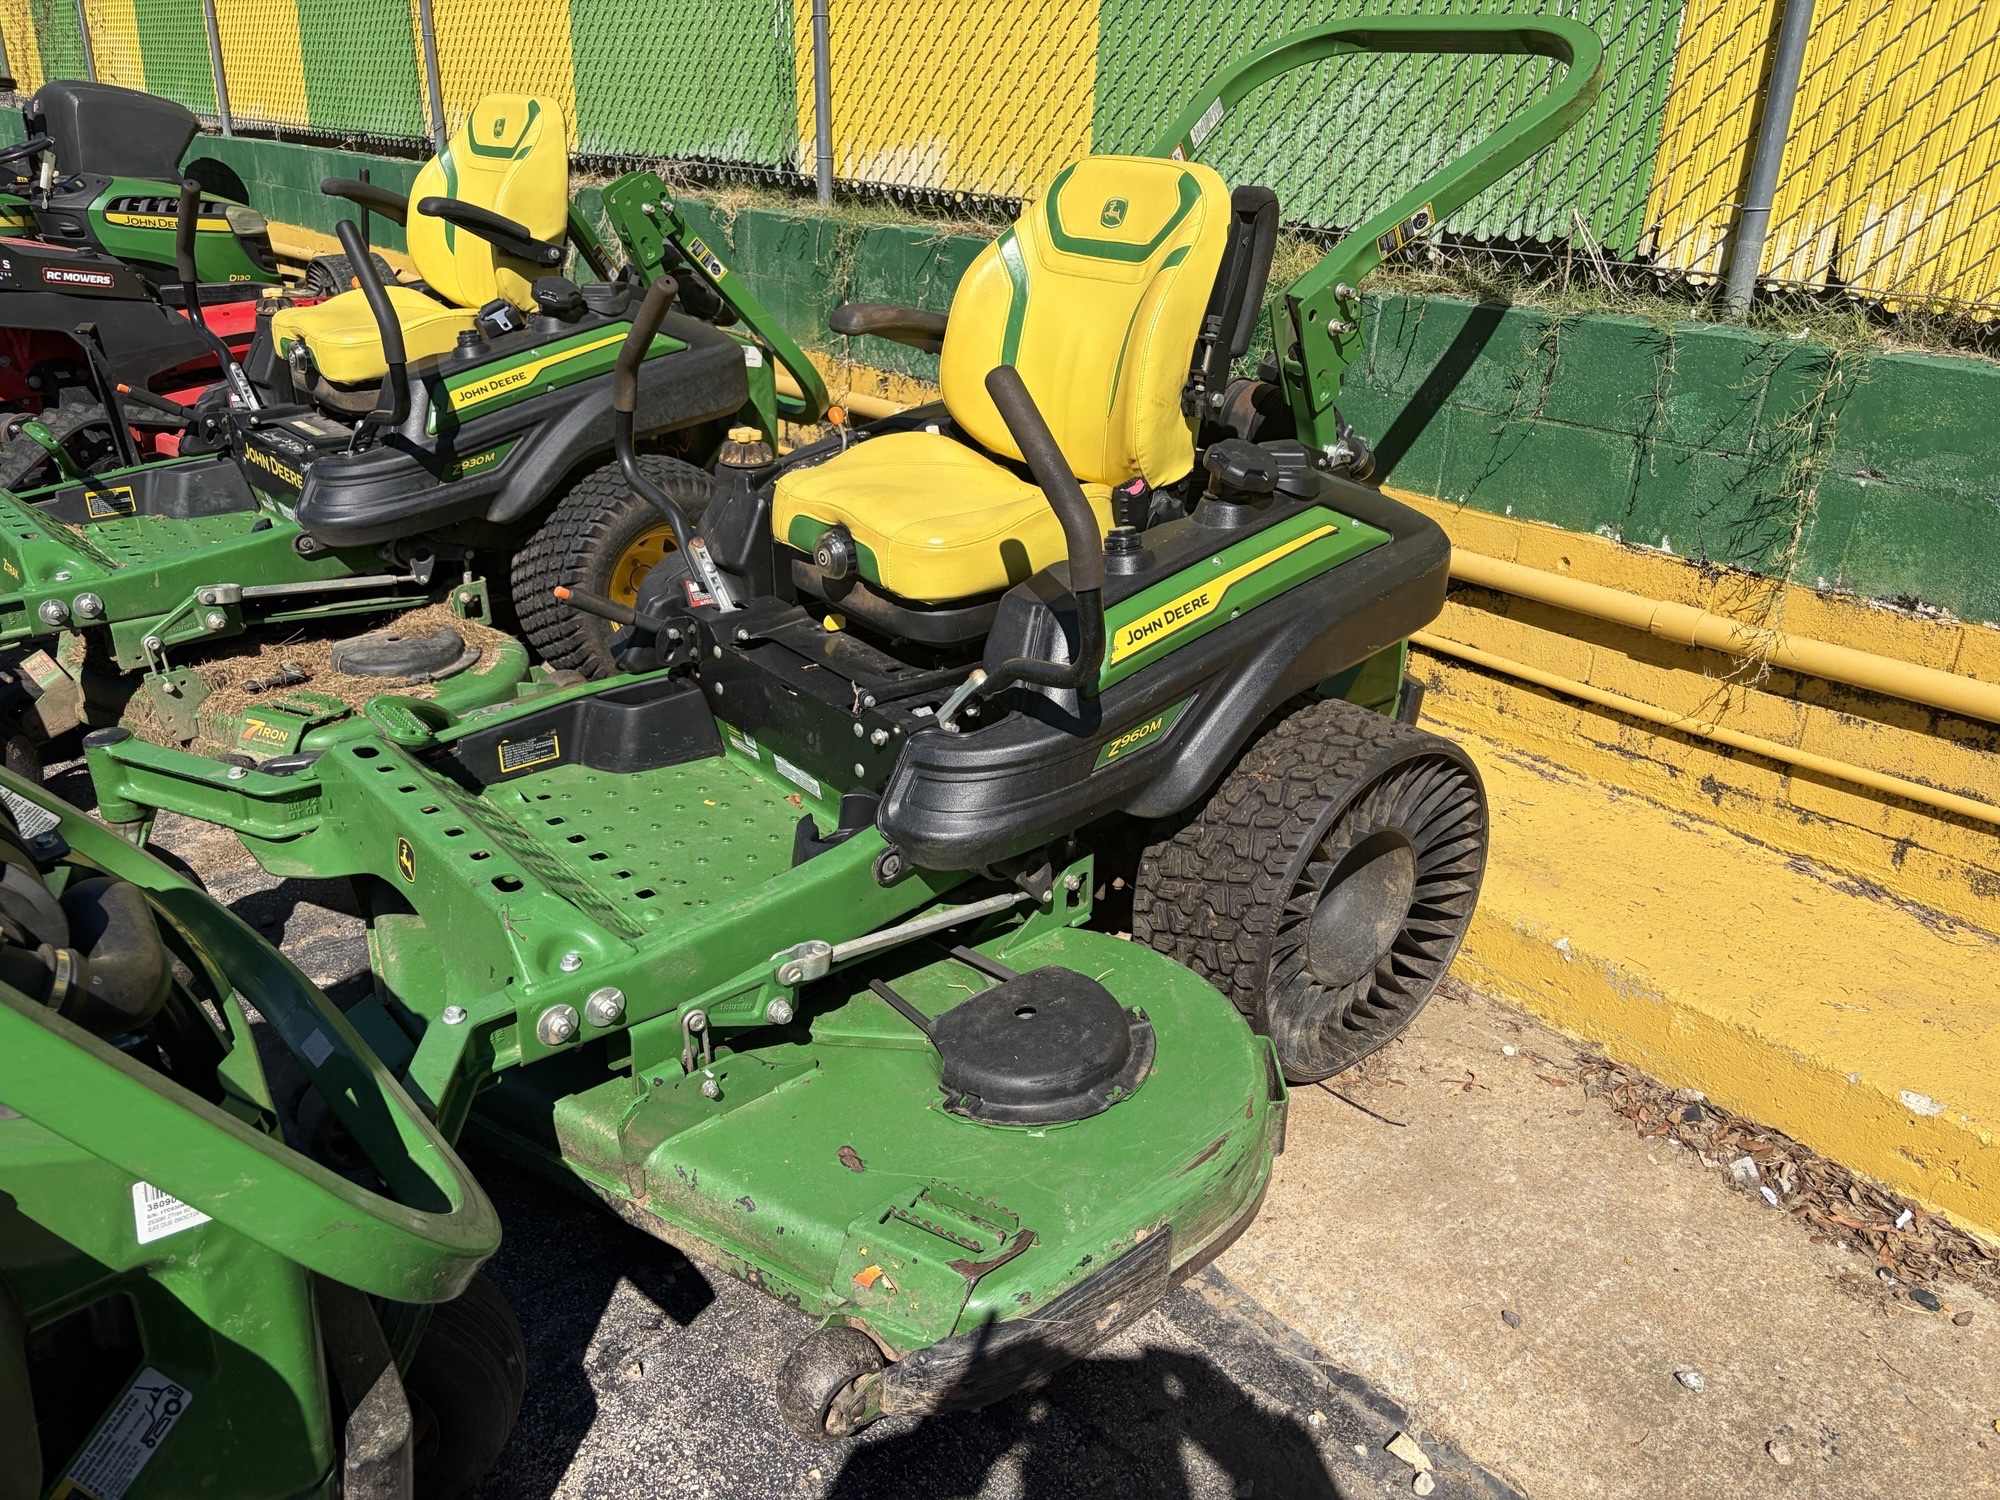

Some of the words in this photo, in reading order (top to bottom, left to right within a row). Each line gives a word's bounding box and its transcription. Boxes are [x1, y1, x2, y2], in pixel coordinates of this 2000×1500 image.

[124, 216, 157, 227] JOHN
[46, 271, 61, 280] RC
[63, 272, 110, 284] MOWERS
[229, 274, 251, 282] D130
[459, 385, 489, 402] JOHN
[489, 372, 526, 390] DEERE
[245, 442, 270, 474] JOHN
[270, 455, 303, 490] DEERE
[452, 452, 495, 476] Z930M
[1127, 618, 1163, 646] JOHN
[1163, 593, 1210, 625] DEERE
[1107, 717, 1163, 758] Z960M
